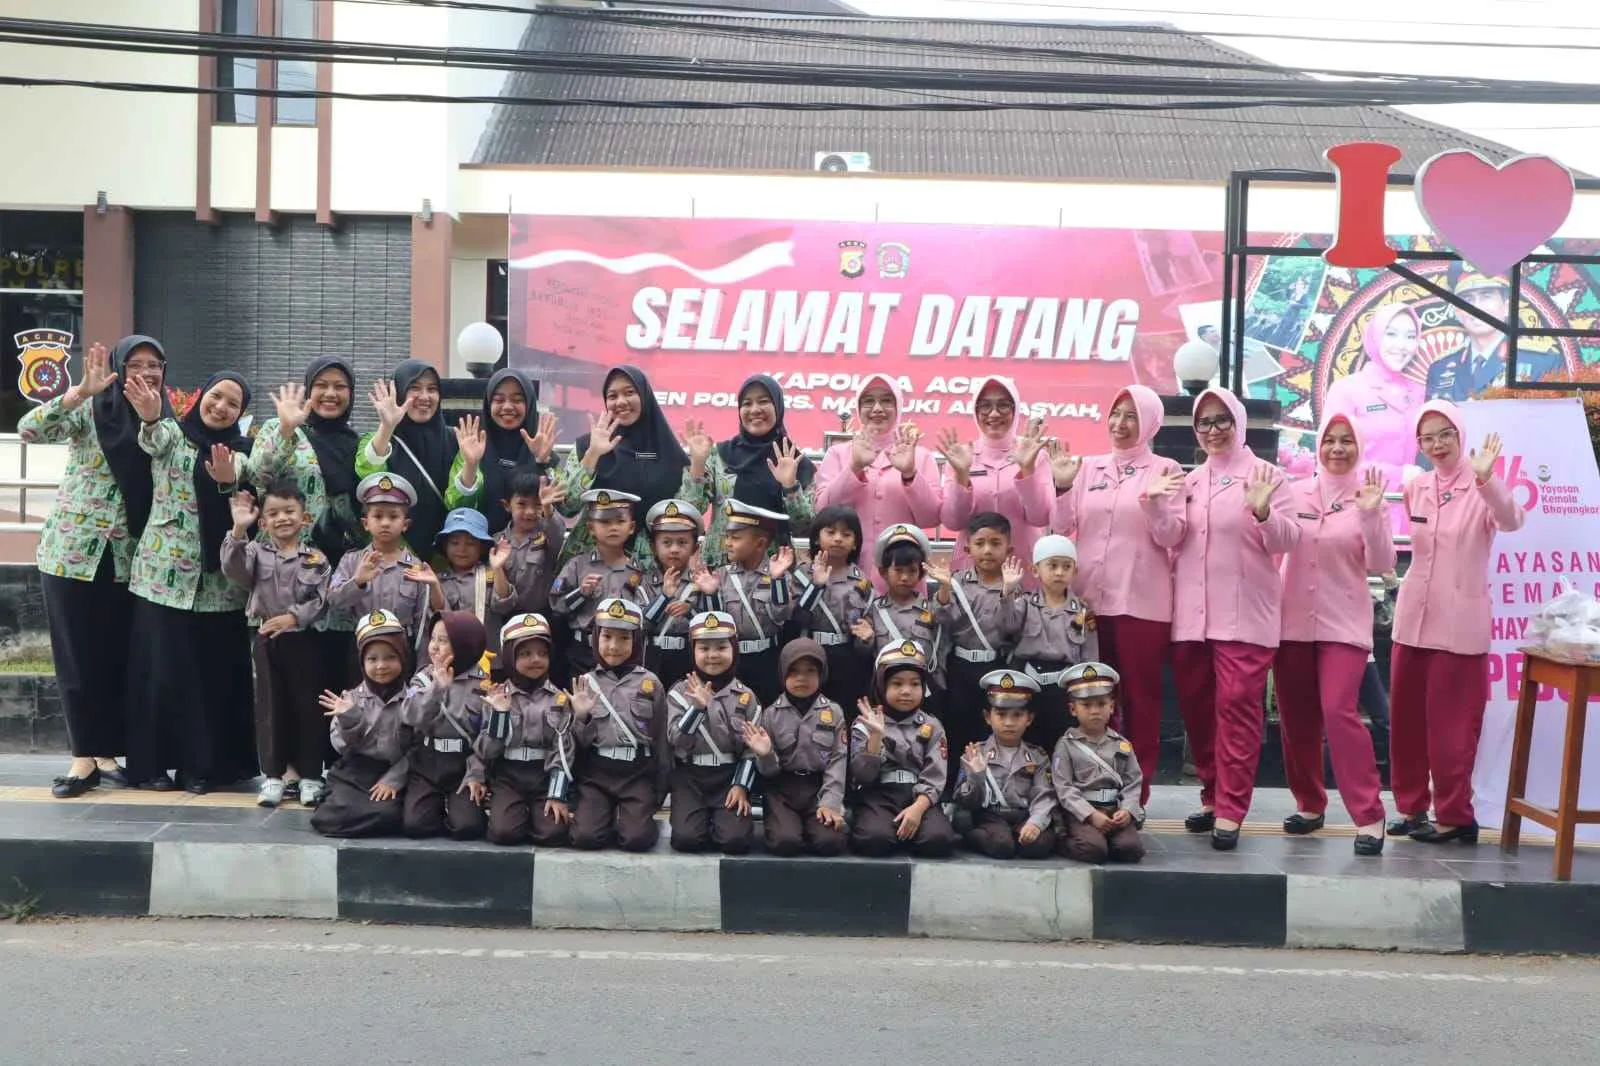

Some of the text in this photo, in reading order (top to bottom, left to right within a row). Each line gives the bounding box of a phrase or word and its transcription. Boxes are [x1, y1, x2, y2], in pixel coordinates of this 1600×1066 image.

[1322, 141, 1403, 268] I
[625, 286, 901, 354] SELAMAT
[909, 293, 1140, 362] DATANG
[22, 333, 66, 343] ACEH
[923, 376, 1015, 394] ACE
[1541, 485, 1580, 495] Yayasan
[1541, 494, 1578, 504] Kemala
